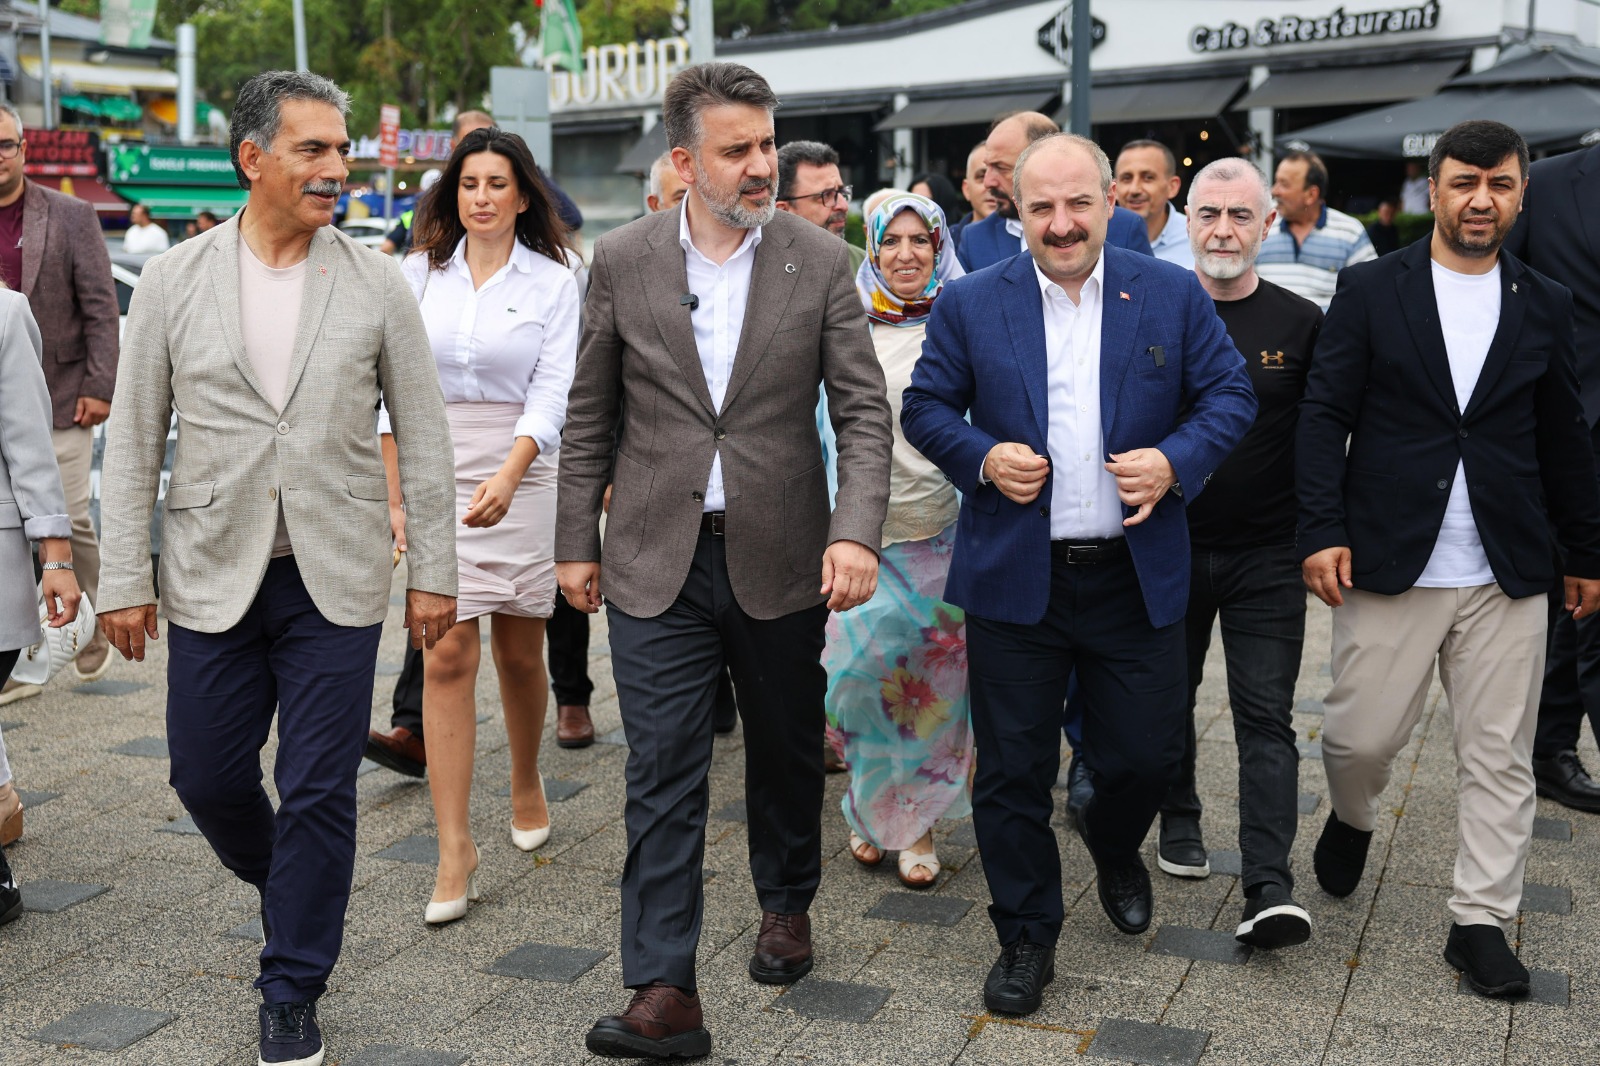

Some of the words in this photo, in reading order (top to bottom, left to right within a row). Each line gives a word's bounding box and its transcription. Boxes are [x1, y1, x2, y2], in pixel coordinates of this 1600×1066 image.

[1190, 22, 1247, 52] Cafe
[1254, 18, 1277, 46] &
[1279, 2, 1438, 43] Restaurant
